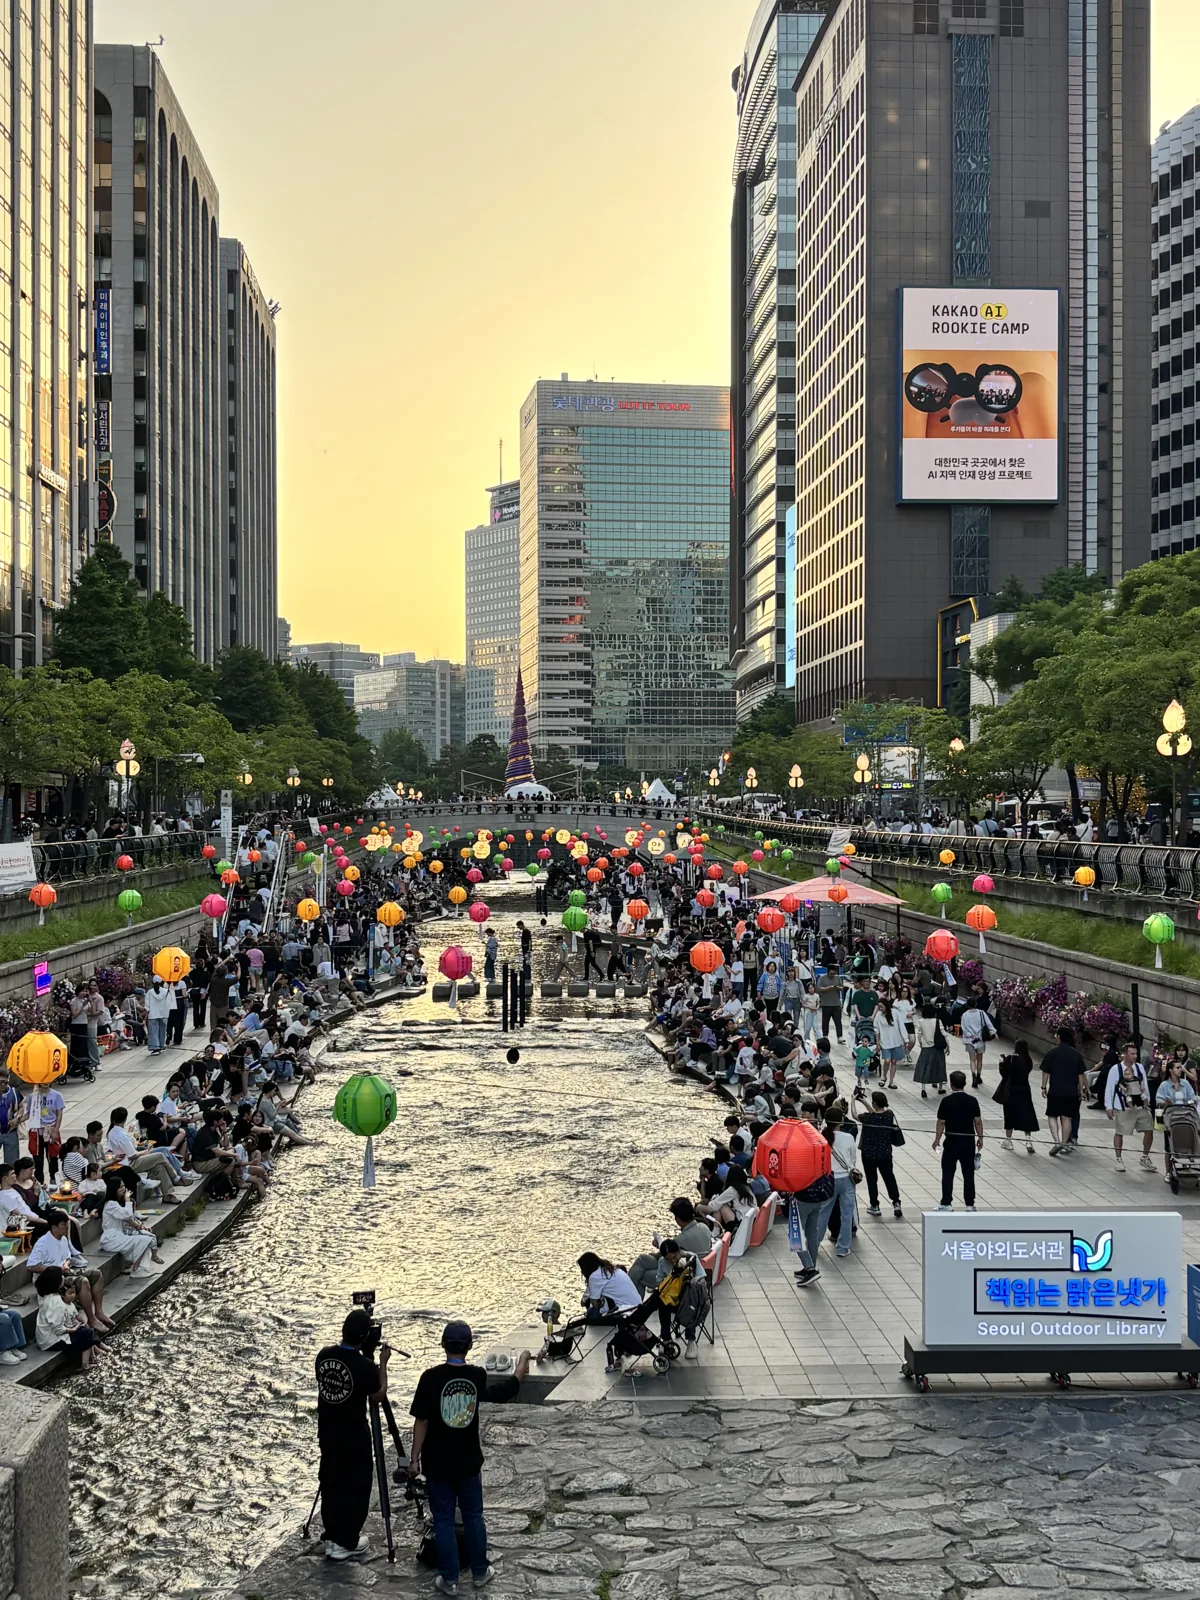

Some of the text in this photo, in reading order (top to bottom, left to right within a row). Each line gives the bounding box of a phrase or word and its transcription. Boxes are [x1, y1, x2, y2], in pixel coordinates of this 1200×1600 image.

[932, 305, 1003, 317] KAKAO AI
[100, 293, 108, 360] 미래이비인후과
[932, 322, 1030, 334] ROOKIE CAMP
[551, 396, 615, 412] 롯데관광
[618, 400, 691, 411] LOTTE TOUR
[934, 457, 1026, 468] 대한민국 곳곳에서 찾은
[927, 470, 1033, 480] AI 지역 인재 양성 프로젝트
[941, 1241, 1065, 1260] 서울야외도서관
[986, 1278, 1062, 1307] 책읽는
[1067, 1278, 1168, 1307] 맑은냇가
[977, 1321, 1166, 1338] Seoul Outdoor Library
[319, 1361, 341, 1374] DEUS
[341, 1369, 350, 1381] EX
